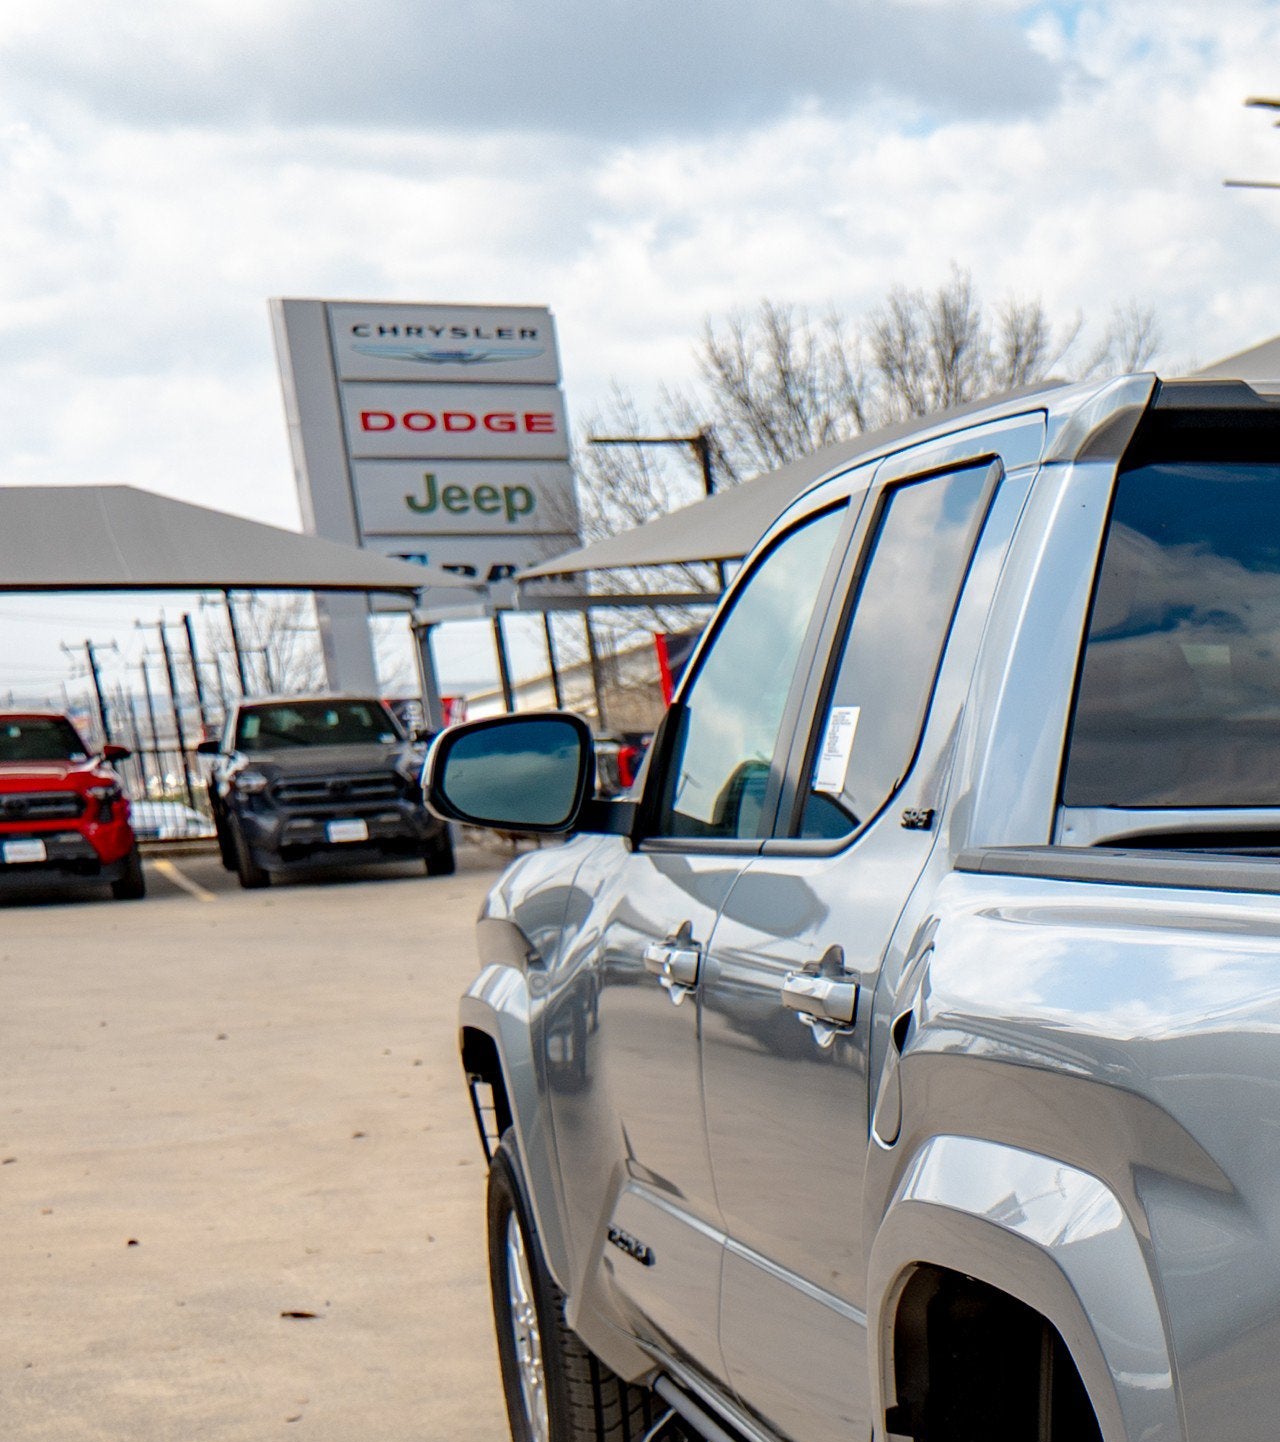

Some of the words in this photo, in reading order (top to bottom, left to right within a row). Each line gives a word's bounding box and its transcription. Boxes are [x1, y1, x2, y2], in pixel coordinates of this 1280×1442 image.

[352, 323, 538, 340] CHRYSLER
[360, 412, 556, 433] DODGE
[405, 474, 536, 522] Jeep
